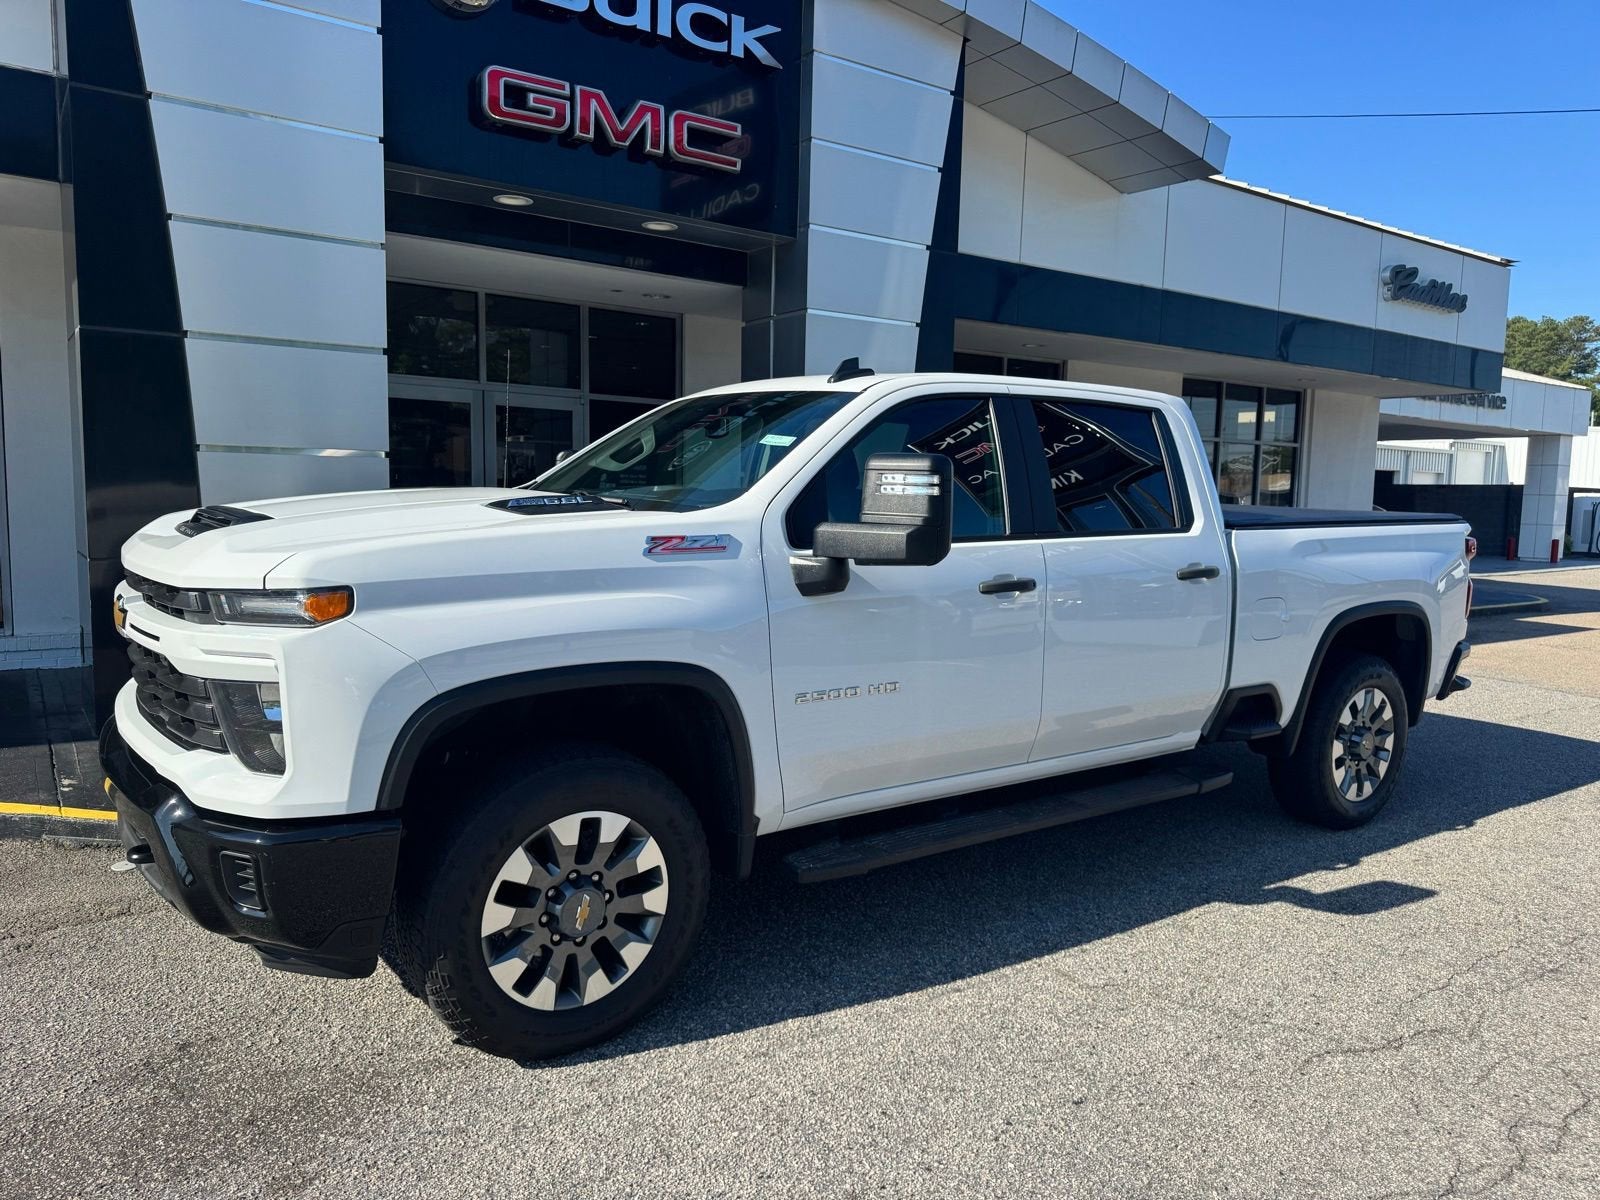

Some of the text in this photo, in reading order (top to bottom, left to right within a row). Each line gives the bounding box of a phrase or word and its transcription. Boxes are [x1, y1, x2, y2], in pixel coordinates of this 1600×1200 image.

[539, 0, 783, 70] UICK
[481, 65, 742, 174] GMC
[795, 681, 900, 705] 2500 HD
